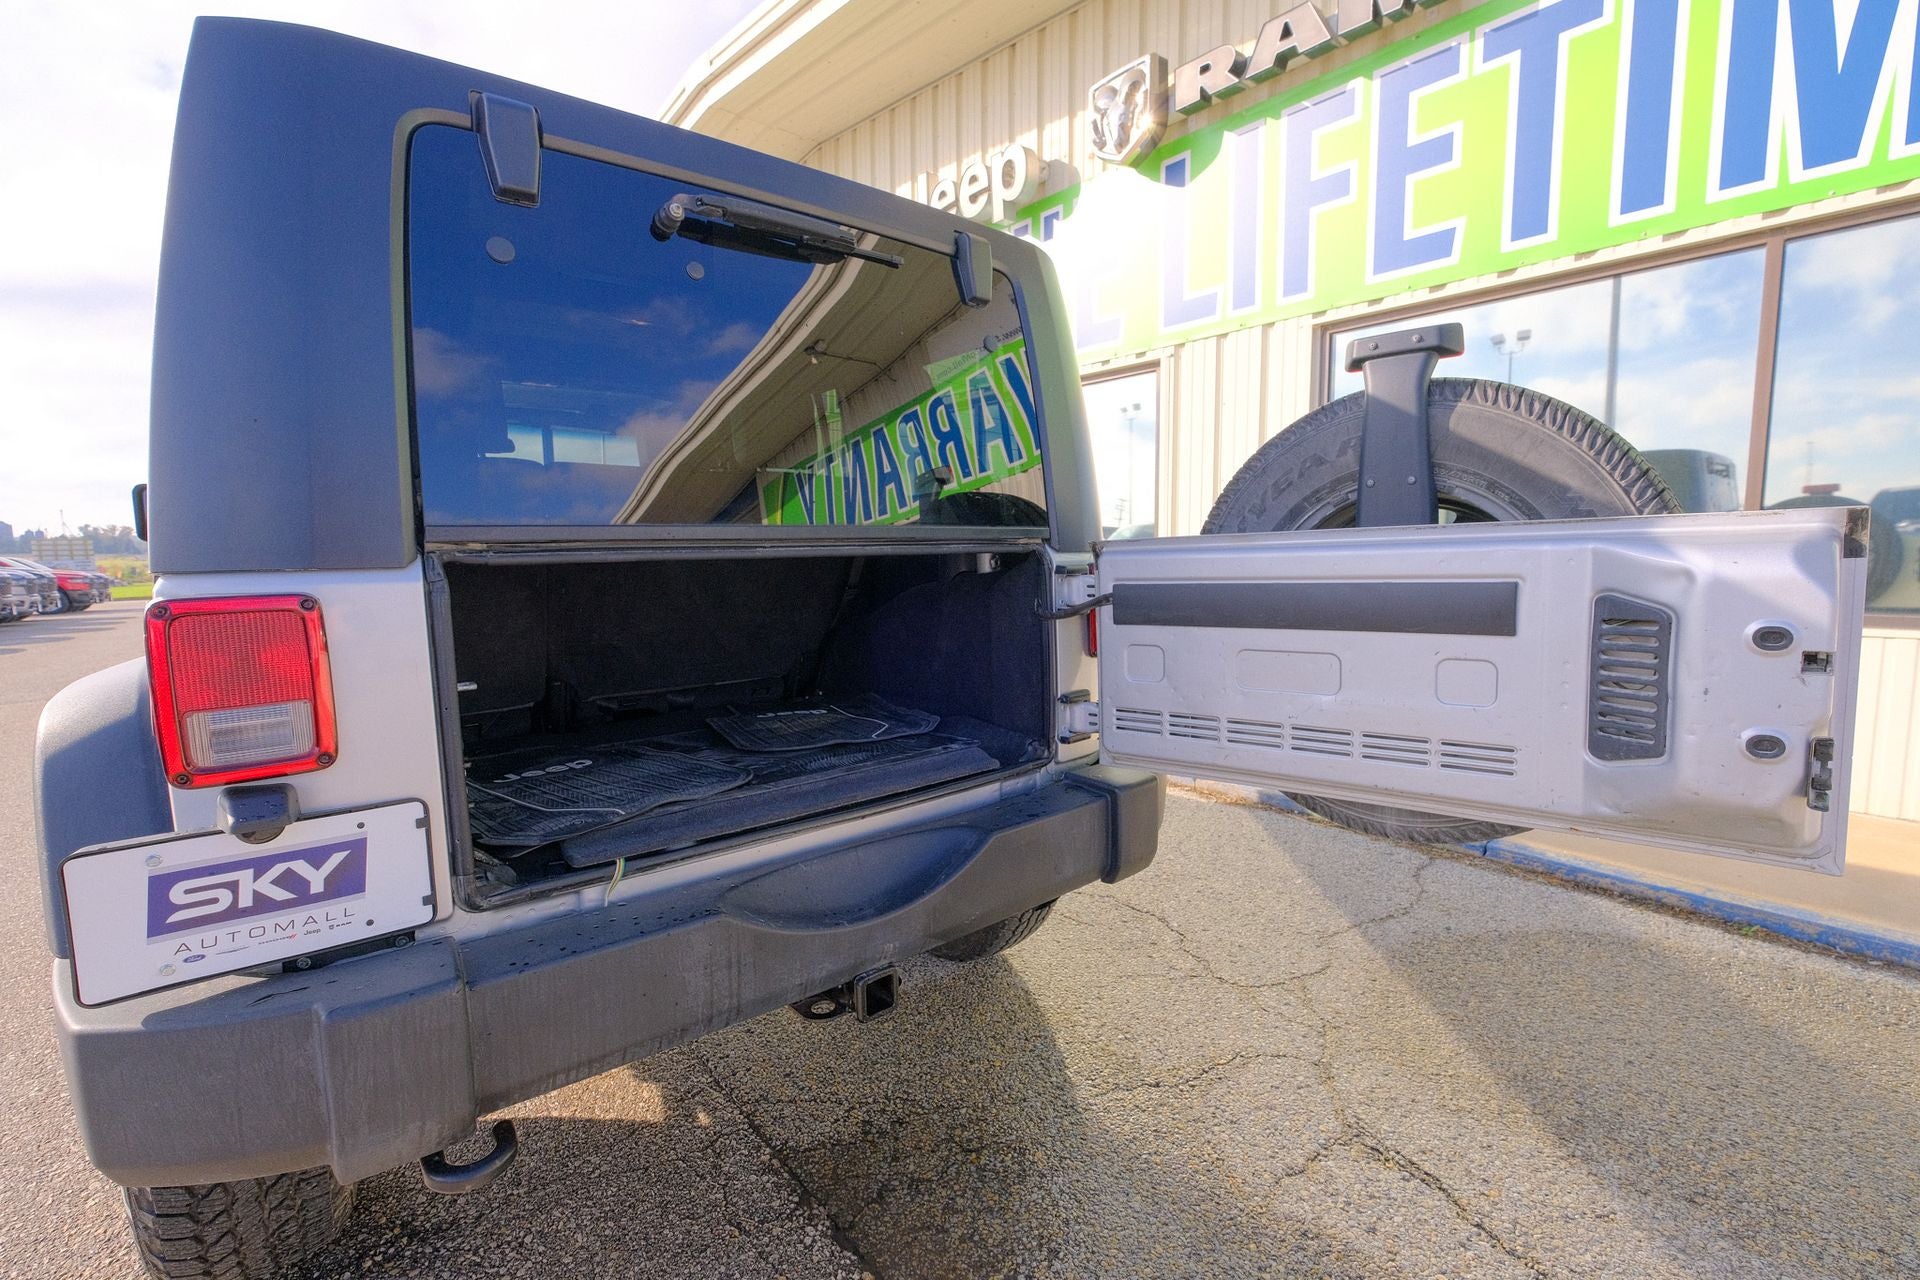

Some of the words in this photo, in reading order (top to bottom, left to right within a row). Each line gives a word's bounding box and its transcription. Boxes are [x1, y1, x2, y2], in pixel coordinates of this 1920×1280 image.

[493, 759, 593, 782] Jeep
[165, 849, 352, 924] SKY
[174, 907, 356, 956] AUTOMALL
[303, 928, 321, 936] Jeep
